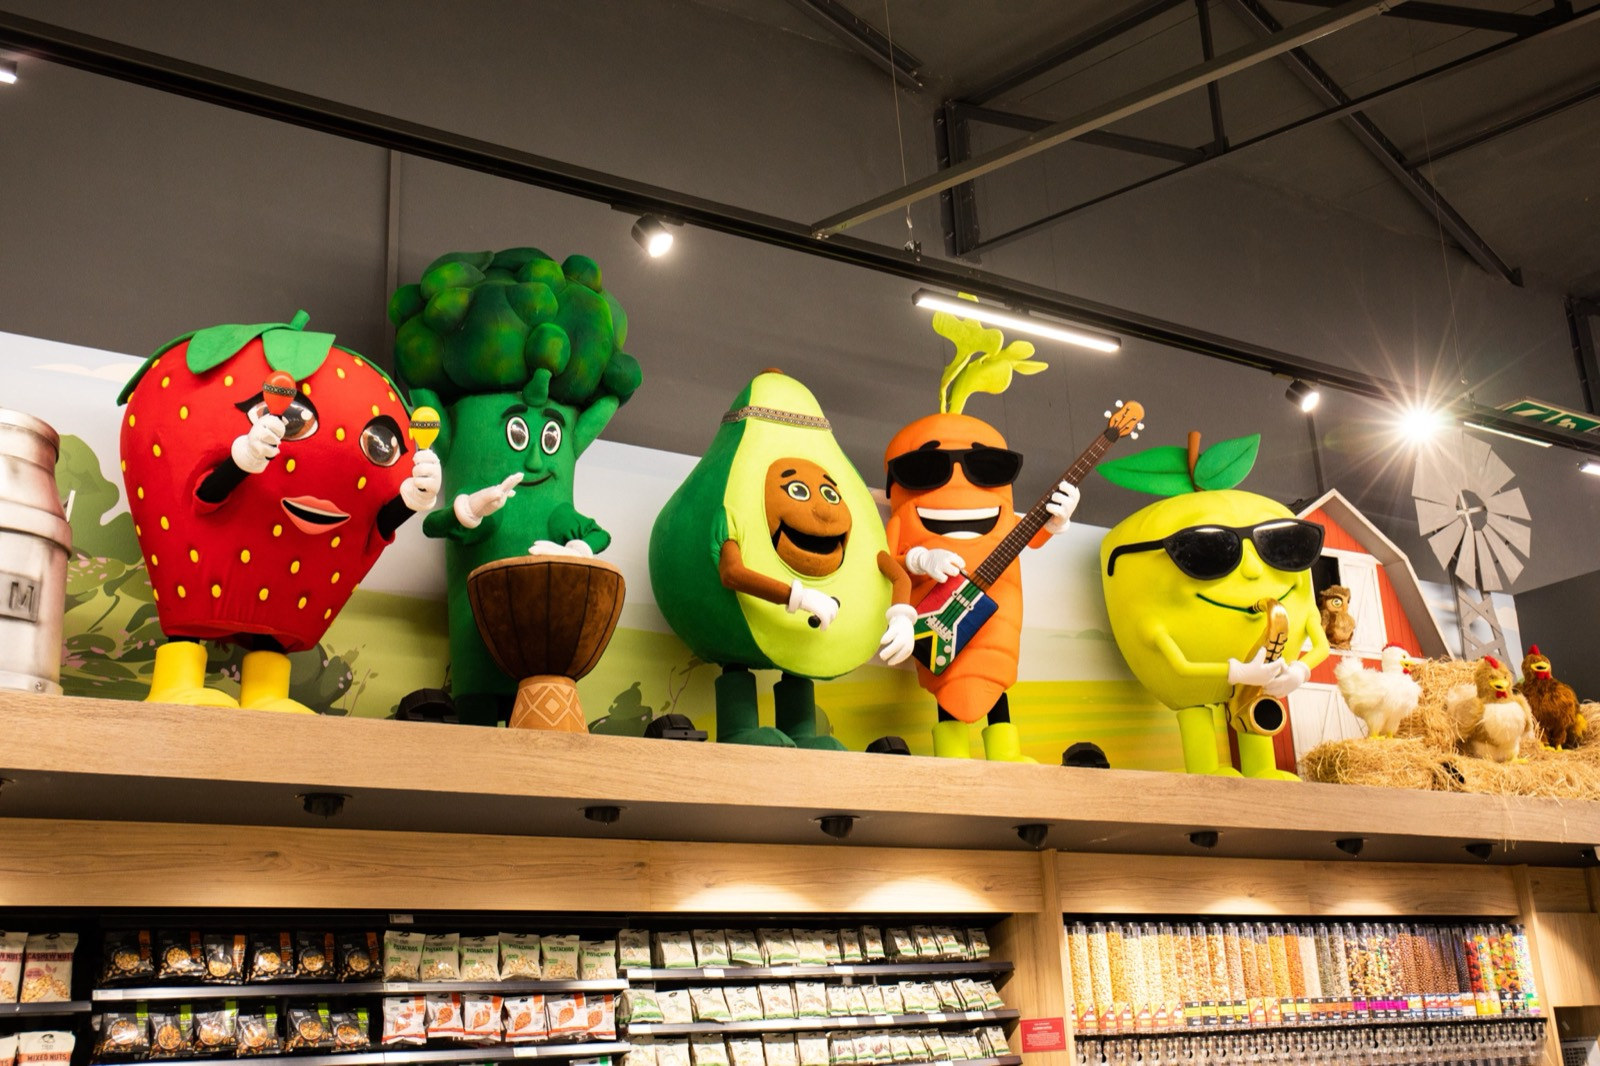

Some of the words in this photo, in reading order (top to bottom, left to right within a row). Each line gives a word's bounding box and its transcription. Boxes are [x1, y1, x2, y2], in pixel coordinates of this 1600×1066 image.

[27, 952, 56, 960] CASHEW
[27, 1053, 49, 1062] MIXED
[49, 1053, 67, 1061] NUTS
